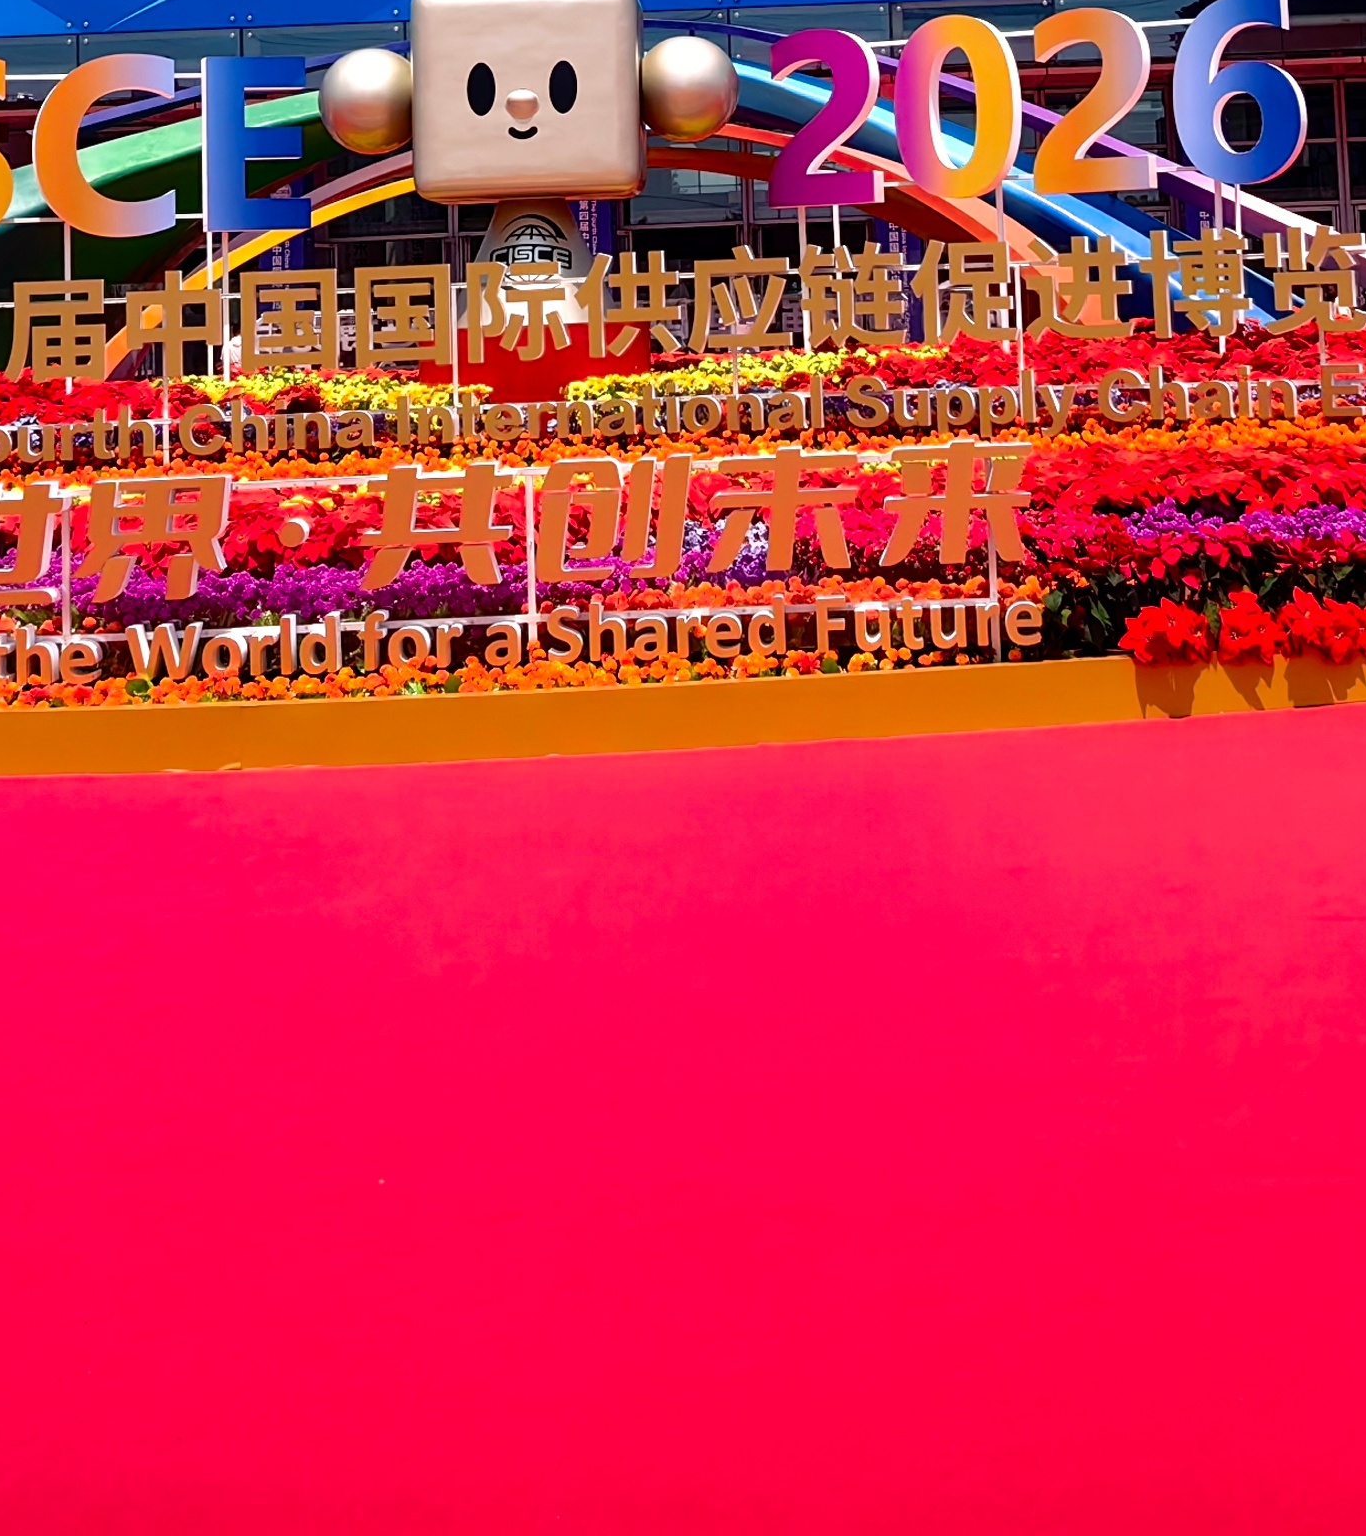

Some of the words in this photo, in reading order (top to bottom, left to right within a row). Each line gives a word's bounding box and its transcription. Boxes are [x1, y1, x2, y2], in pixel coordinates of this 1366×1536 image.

[178, 397, 376, 457] China
[397, 374, 824, 447] International
[845, 368, 1074, 438] Supply
[1096, 365, 1299, 423] Chain
[126, 610, 343, 680] World
[357, 609, 465, 672] for
[484, 618, 525, 668] a
[547, 592, 788, 664] Shared
[814, 592, 1045, 654] Future
